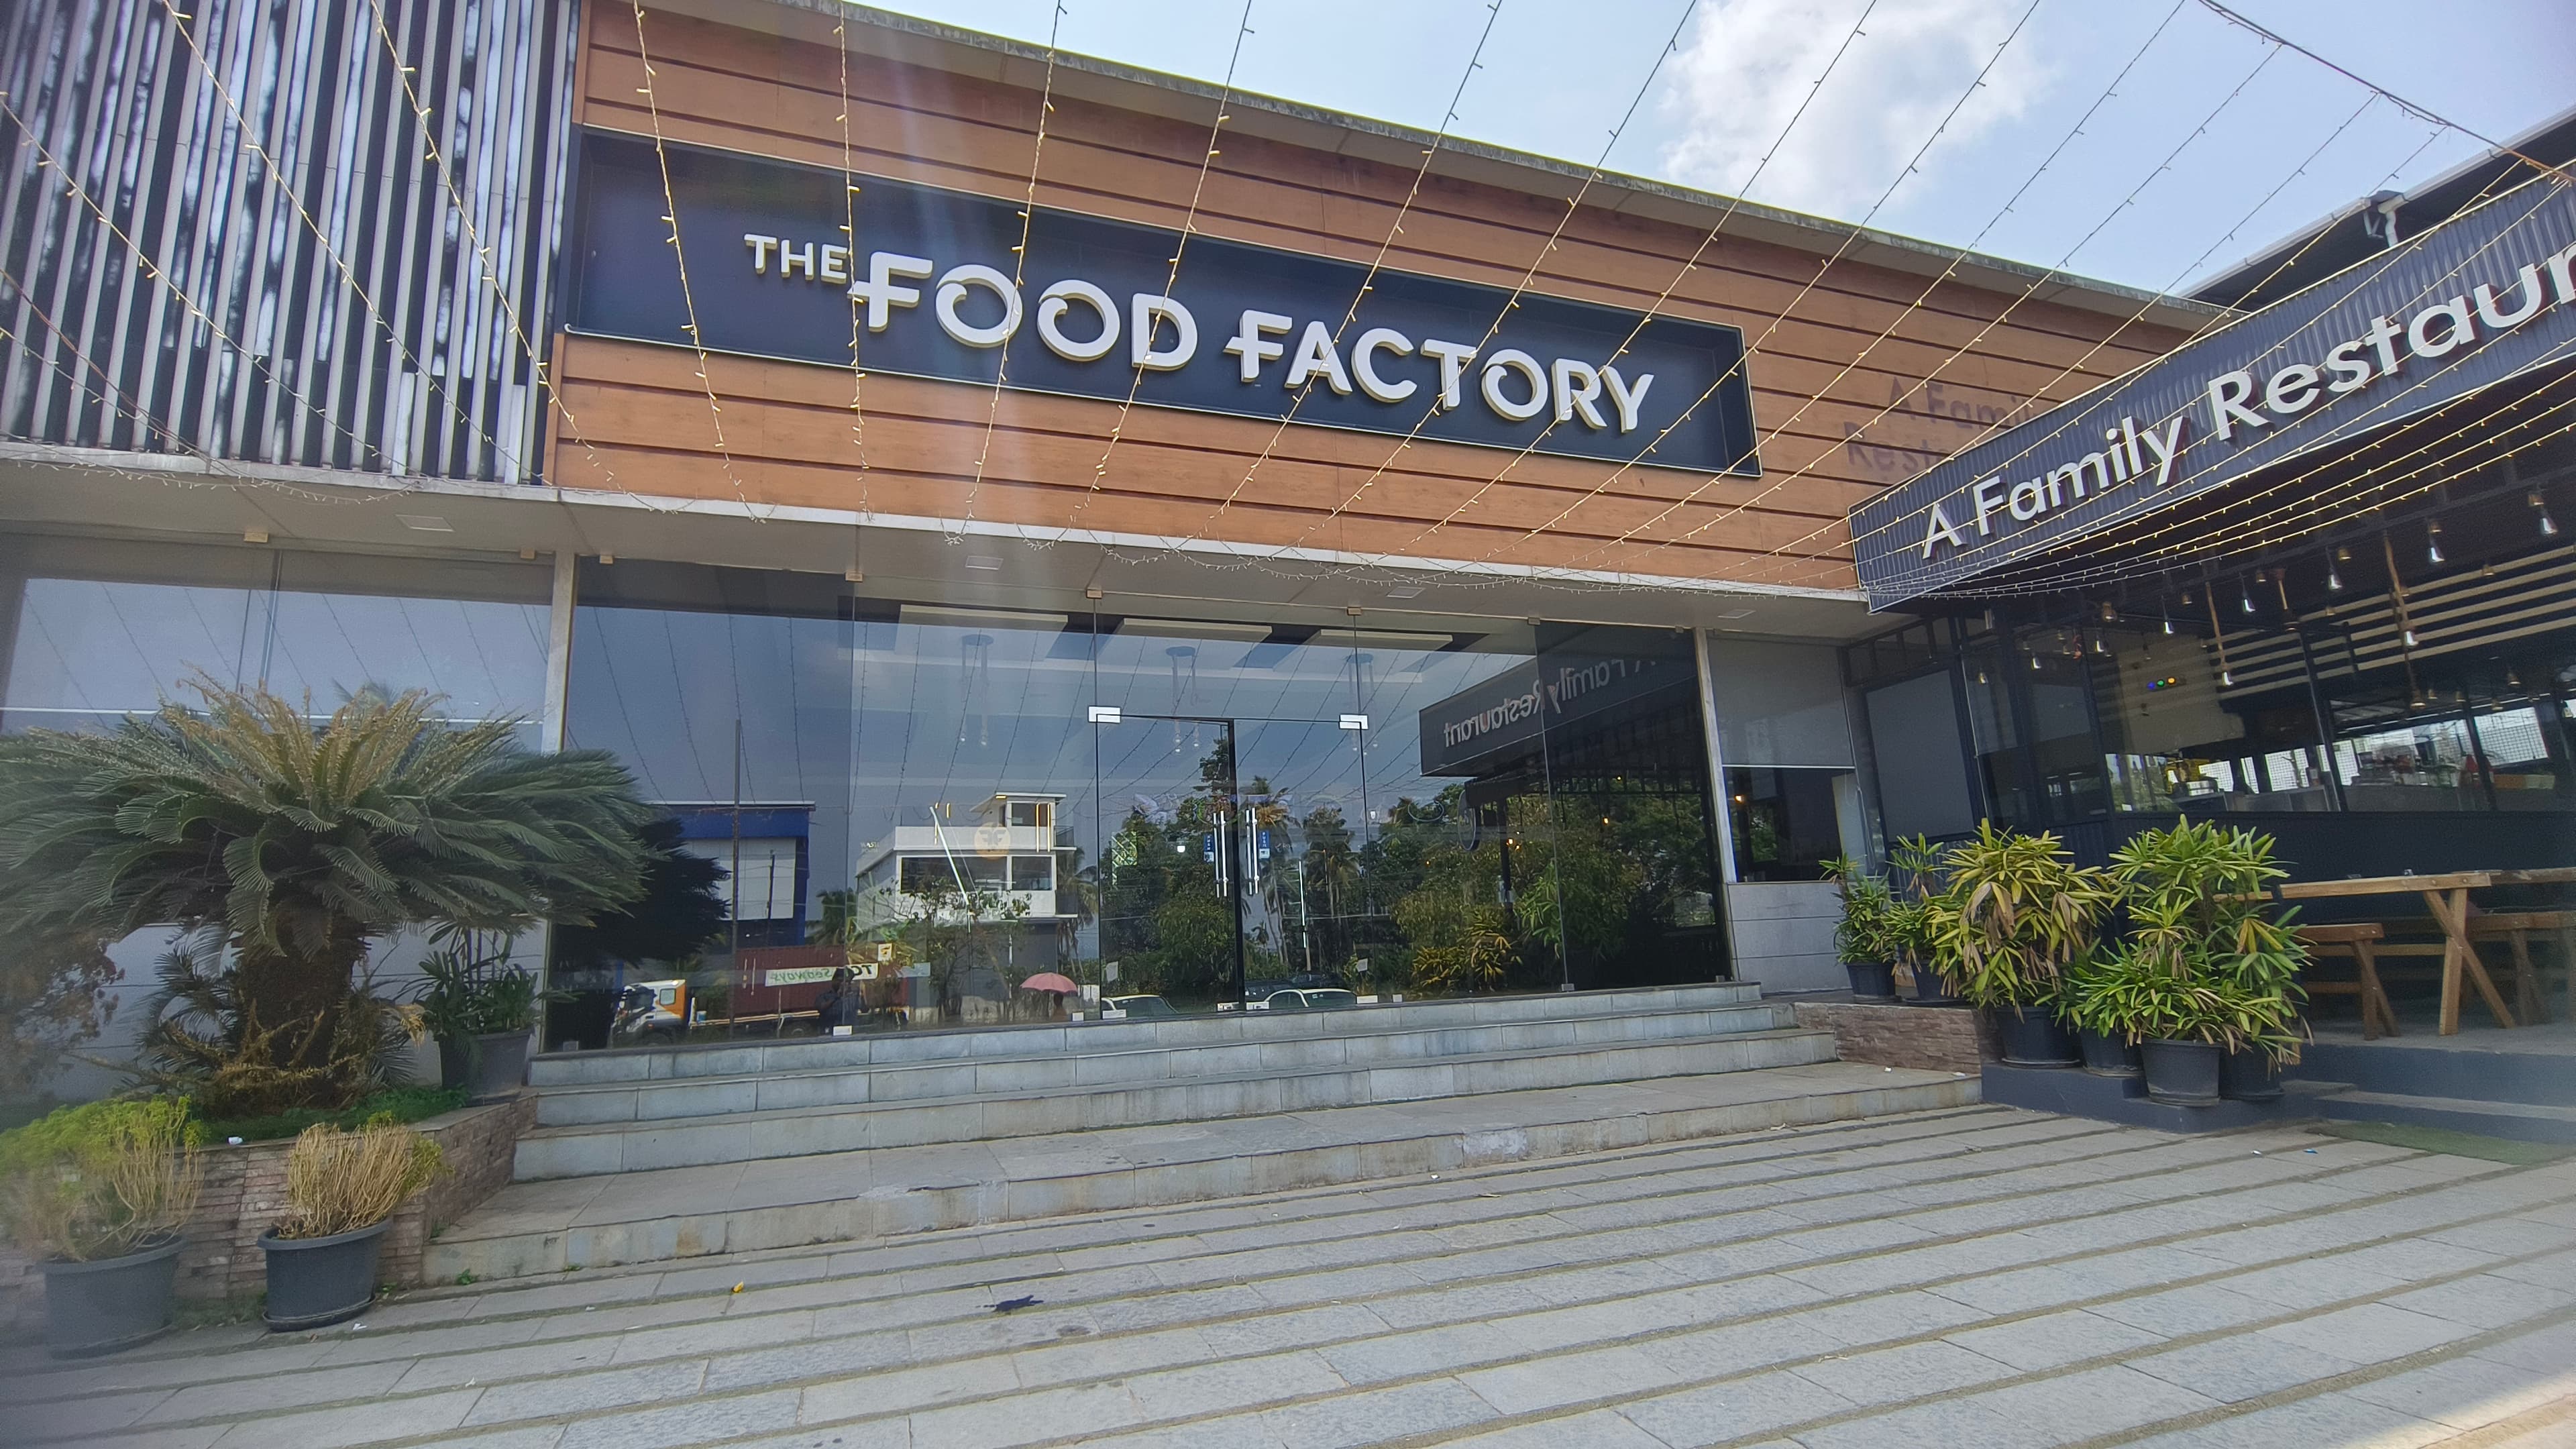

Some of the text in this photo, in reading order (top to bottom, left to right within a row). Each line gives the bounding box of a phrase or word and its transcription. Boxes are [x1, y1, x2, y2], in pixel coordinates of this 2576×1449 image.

[744, 233, 1655, 434] THE FOOD FACTORY
[1922, 242, 2576, 559] A Family Restaur
